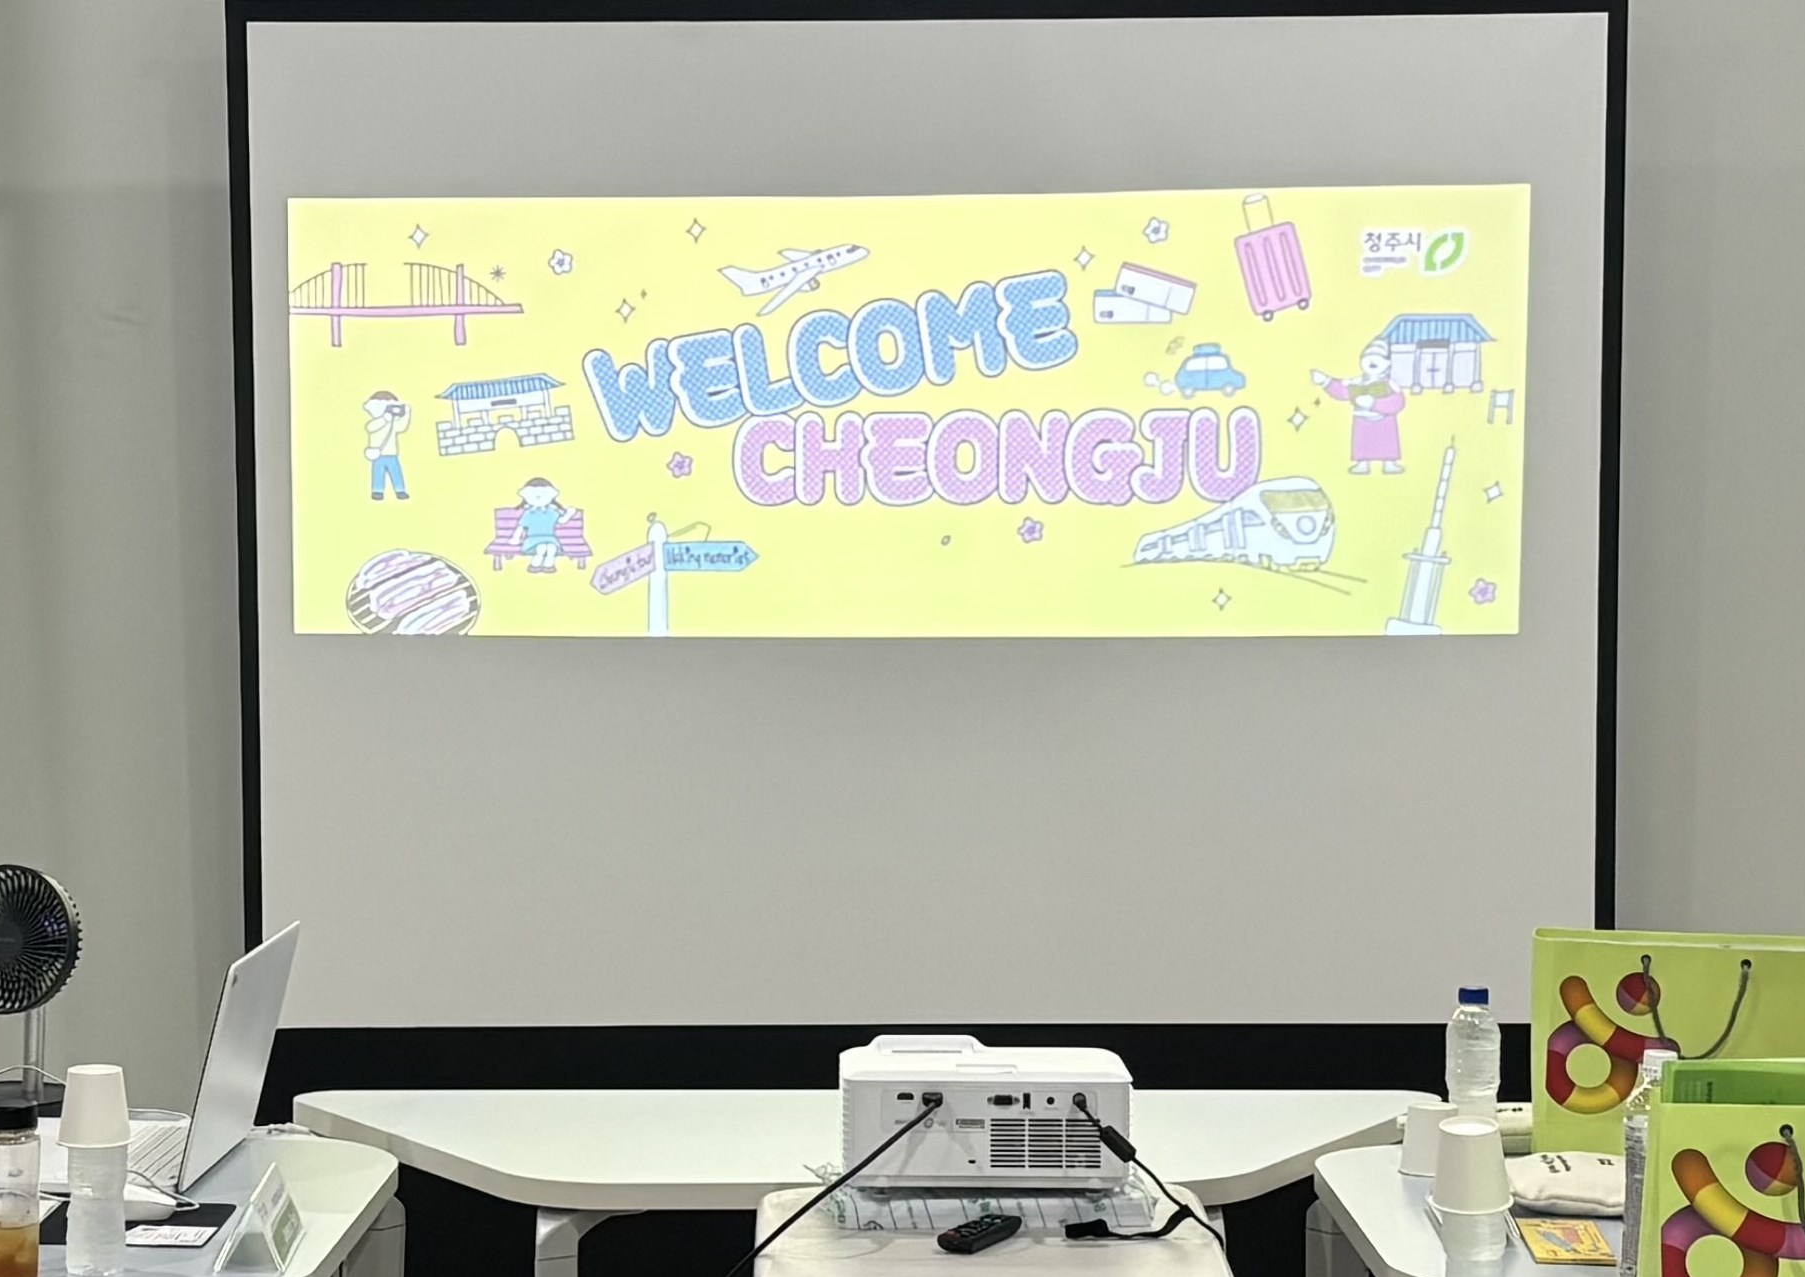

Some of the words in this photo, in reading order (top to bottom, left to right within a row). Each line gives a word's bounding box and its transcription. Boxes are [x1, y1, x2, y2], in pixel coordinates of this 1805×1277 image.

[1364, 232, 1422, 253] 청주시
[582, 269, 1079, 442] WELCOME
[732, 405, 1262, 505] CHEONGJU
